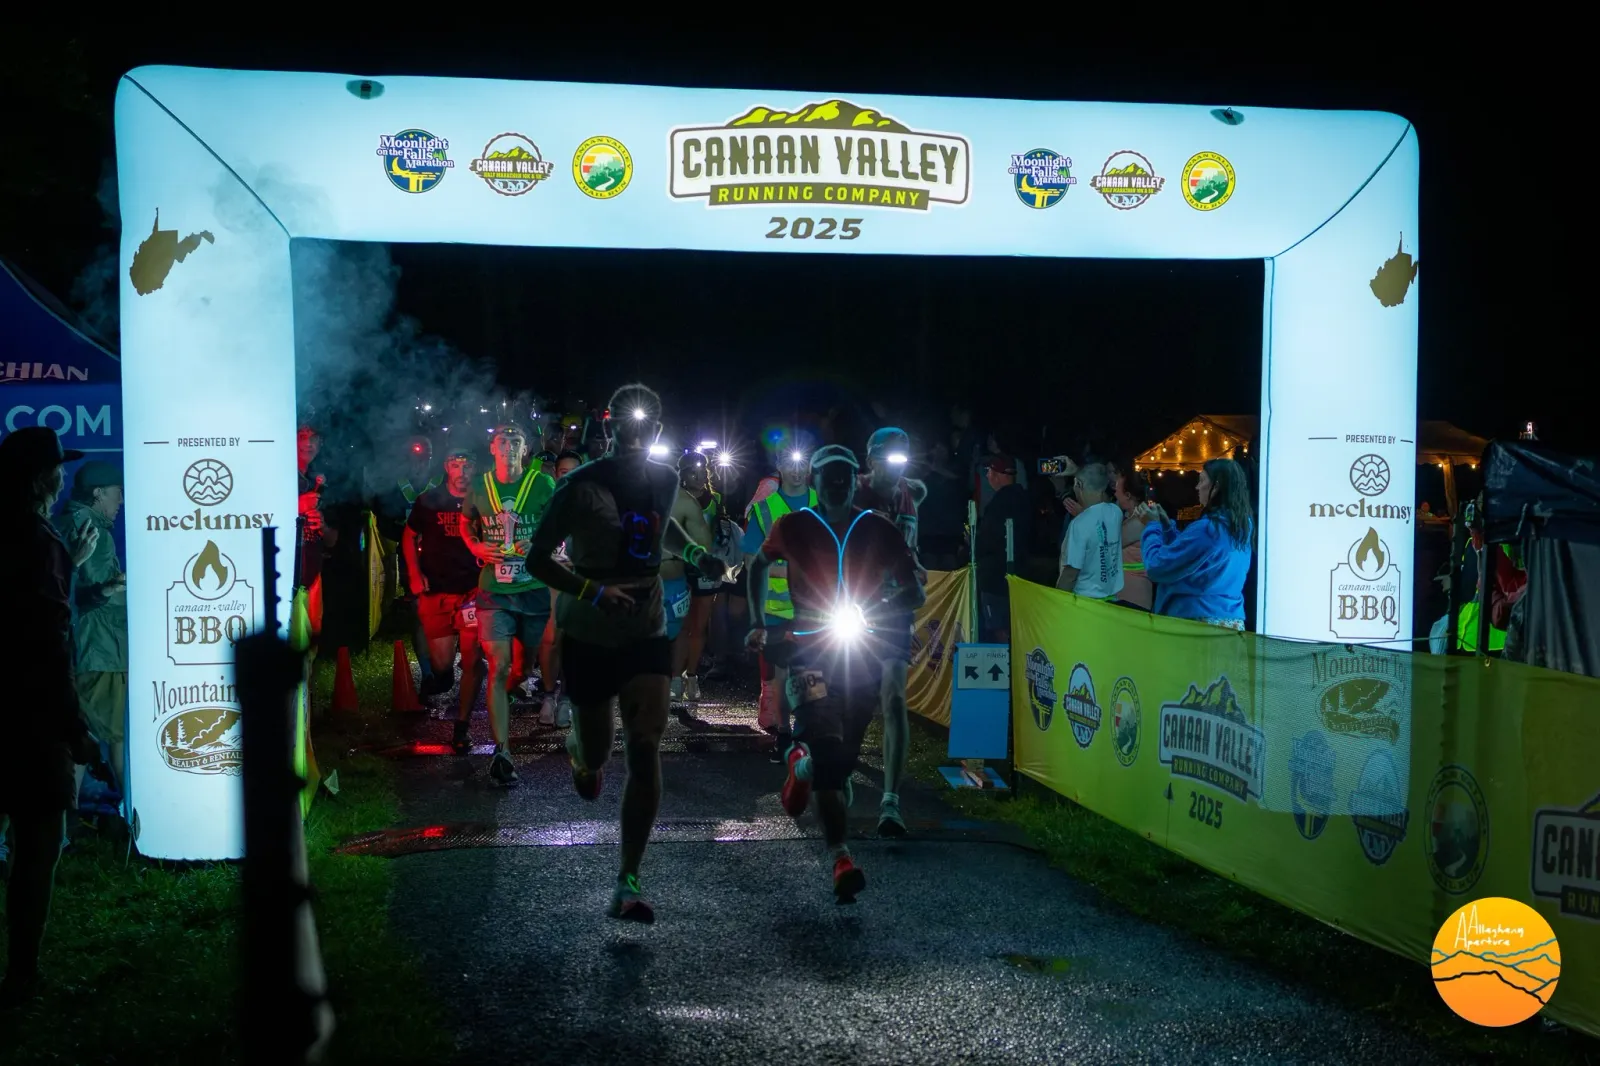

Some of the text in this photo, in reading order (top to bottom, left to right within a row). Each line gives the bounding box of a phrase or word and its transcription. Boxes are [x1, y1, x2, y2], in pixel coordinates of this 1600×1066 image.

[381, 136, 448, 151] Moonlight
[403, 148, 433, 160] Falls
[682, 135, 959, 185] CANAAN VALLEY
[405, 159, 453, 168] Marathon
[477, 160, 550, 174] CANAAN VALLEY
[1012, 155, 1072, 169] Moonlight
[1031, 166, 1058, 177] Falls
[1033, 175, 1076, 185] Marathon
[1096, 177, 1161, 188] CANAAN VALLEY
[718, 186, 920, 206] RUNNING COMPANY
[765, 216, 863, 240] 2025
[177, 437, 240, 447] PRESENTED BY
[1345, 434, 1396, 445] PRESENTED BY
[1309, 498, 1412, 524] mcclumsy
[1338, 582, 1397, 595] canaan valley
[174, 600, 247, 614] canaan valley
[1337, 594, 1398, 625] BBQ
[173, 615, 248, 648] BBQ
[1311, 652, 1389, 691] Mountain
[1164, 713, 1211, 756] CANAAN
[1216, 722, 1259, 780] VALLEY
[172, 758, 201, 768] REALTY
[1173, 758, 1245, 793] RUNNING COMPANY
[1189, 791, 1223, 829] 2025
[1542, 824, 1600, 881] CAN
